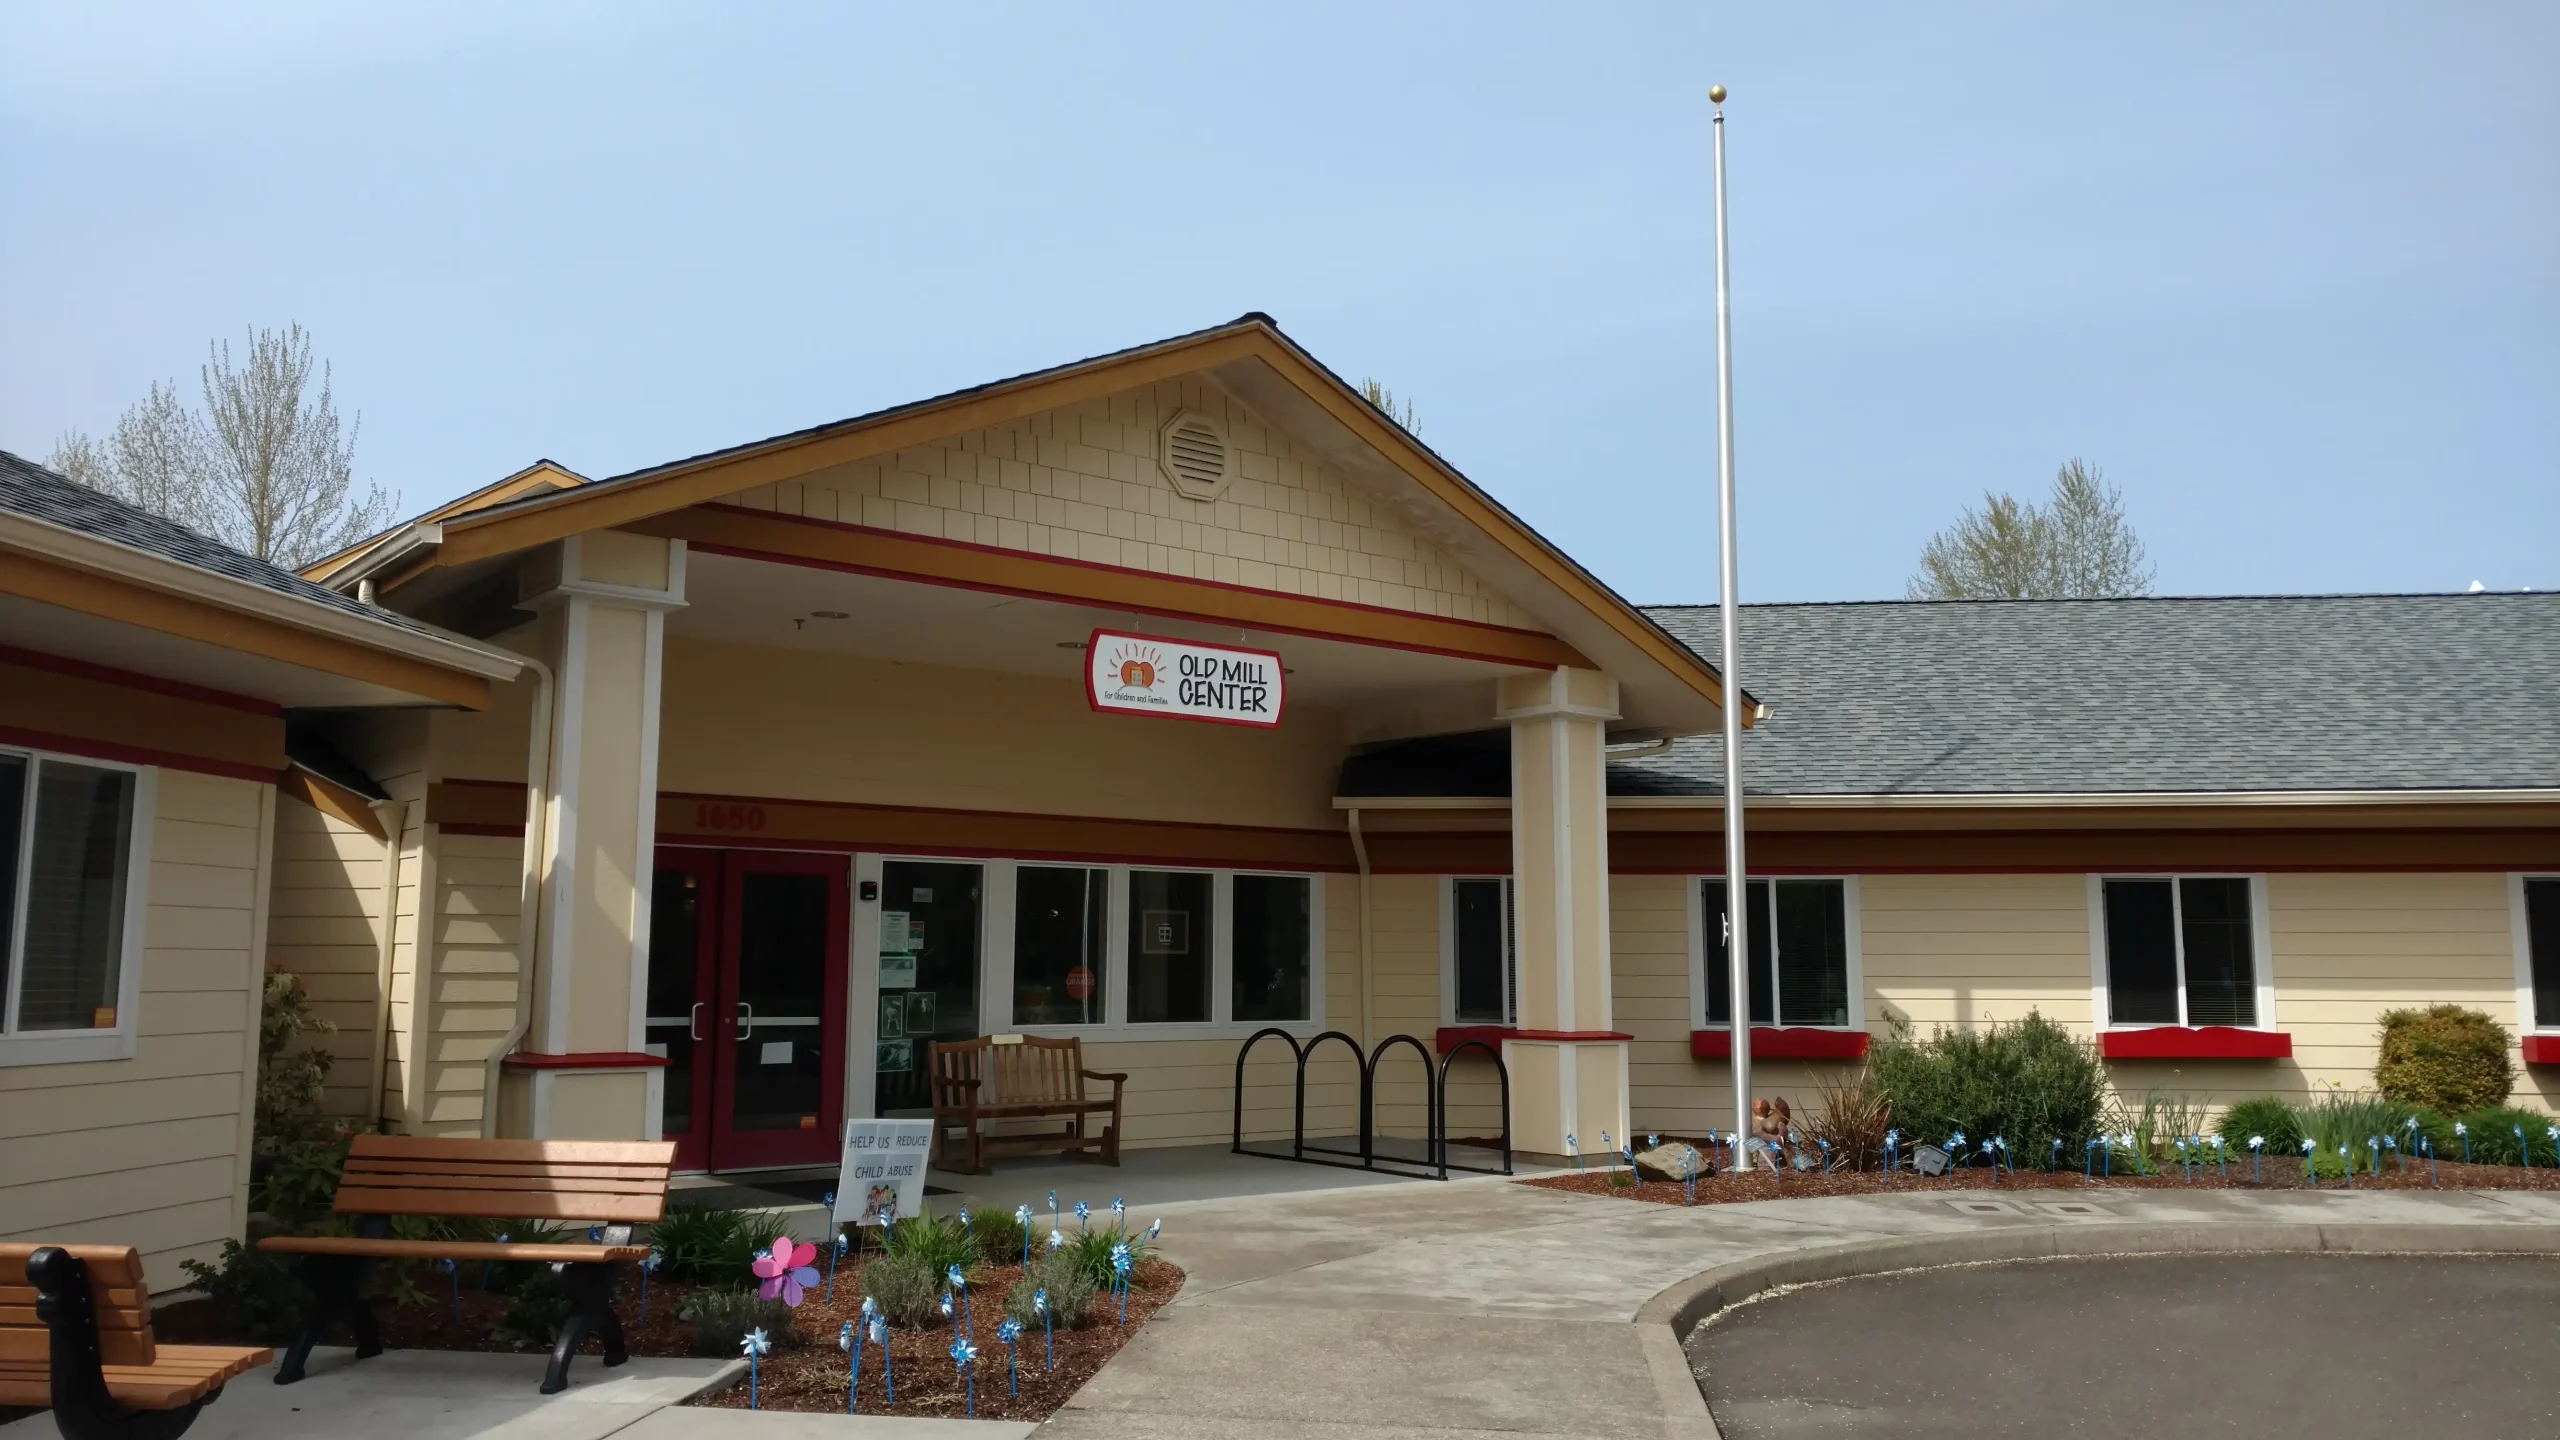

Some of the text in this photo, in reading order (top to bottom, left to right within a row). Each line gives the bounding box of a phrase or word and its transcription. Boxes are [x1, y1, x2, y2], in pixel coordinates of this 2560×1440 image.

[1179, 654, 1268, 685] OLD MILL
[1104, 690, 1168, 705] For Children and Families
[1179, 678, 1268, 713] CENTER
[696, 803, 767, 831] 1650
[849, 1135, 928, 1149] HELP US REDUCE
[855, 1165, 914, 1179] CHILD ABUSE
